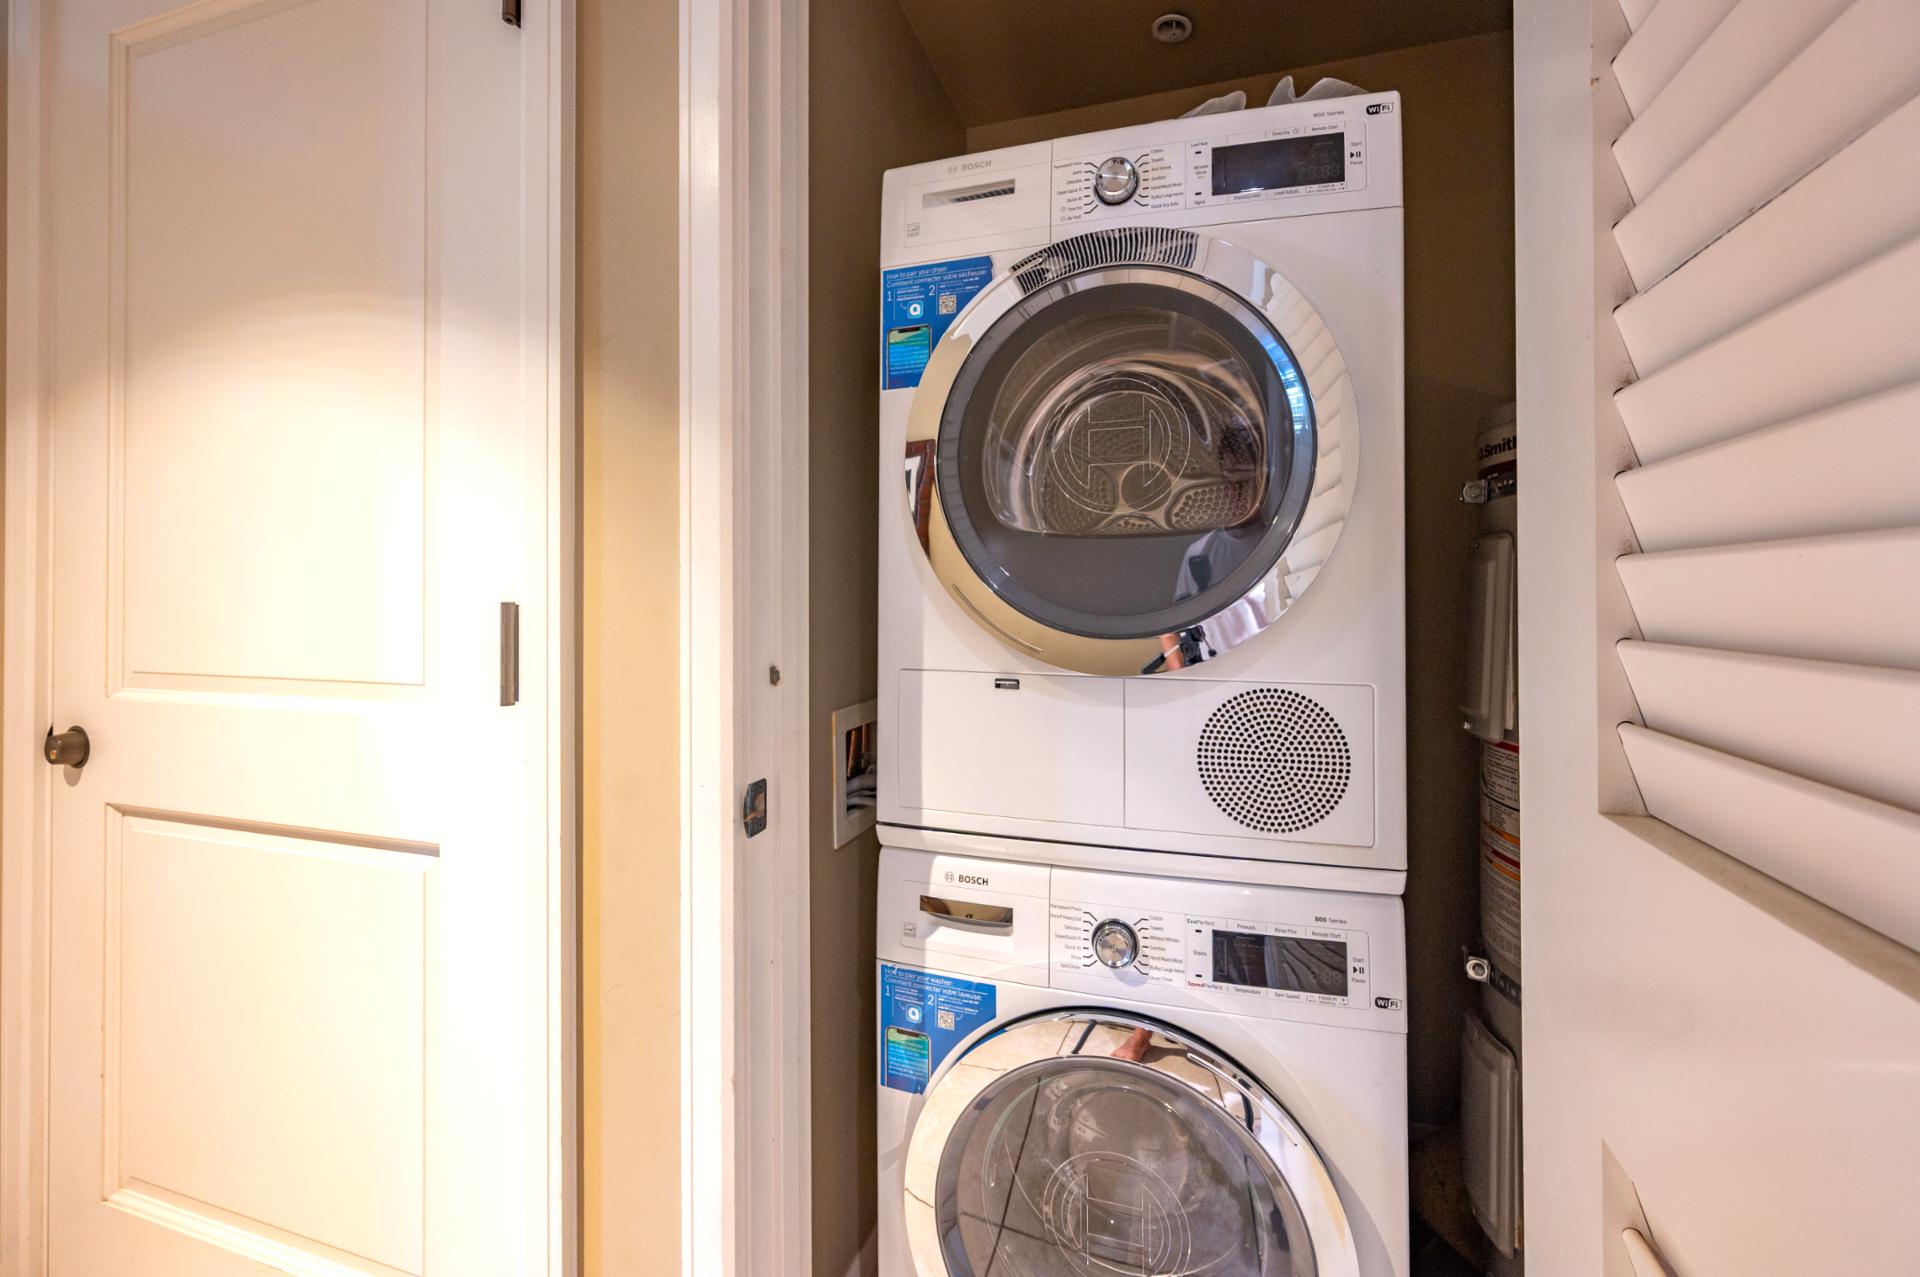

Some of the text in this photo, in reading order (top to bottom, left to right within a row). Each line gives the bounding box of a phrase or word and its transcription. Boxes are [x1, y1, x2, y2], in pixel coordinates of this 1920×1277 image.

[961, 160, 992, 172] BOSCH
[906, 271, 916, 279] pair
[918, 269, 930, 277] your
[887, 279, 913, 288] Comment
[929, 285, 935, 296] 2
[888, 291, 892, 302] 1
[958, 874, 989, 886] BOSCH
[1187, 918, 1214, 926] EcoPerfect
[885, 977, 912, 987] Comment
[912, 982, 940, 993] connecter
[942, 988, 957, 996] votre
[885, 986, 891, 996] 1
[1188, 981, 1223, 991] SpeedPerfect
[928, 994, 934, 1006] 2
